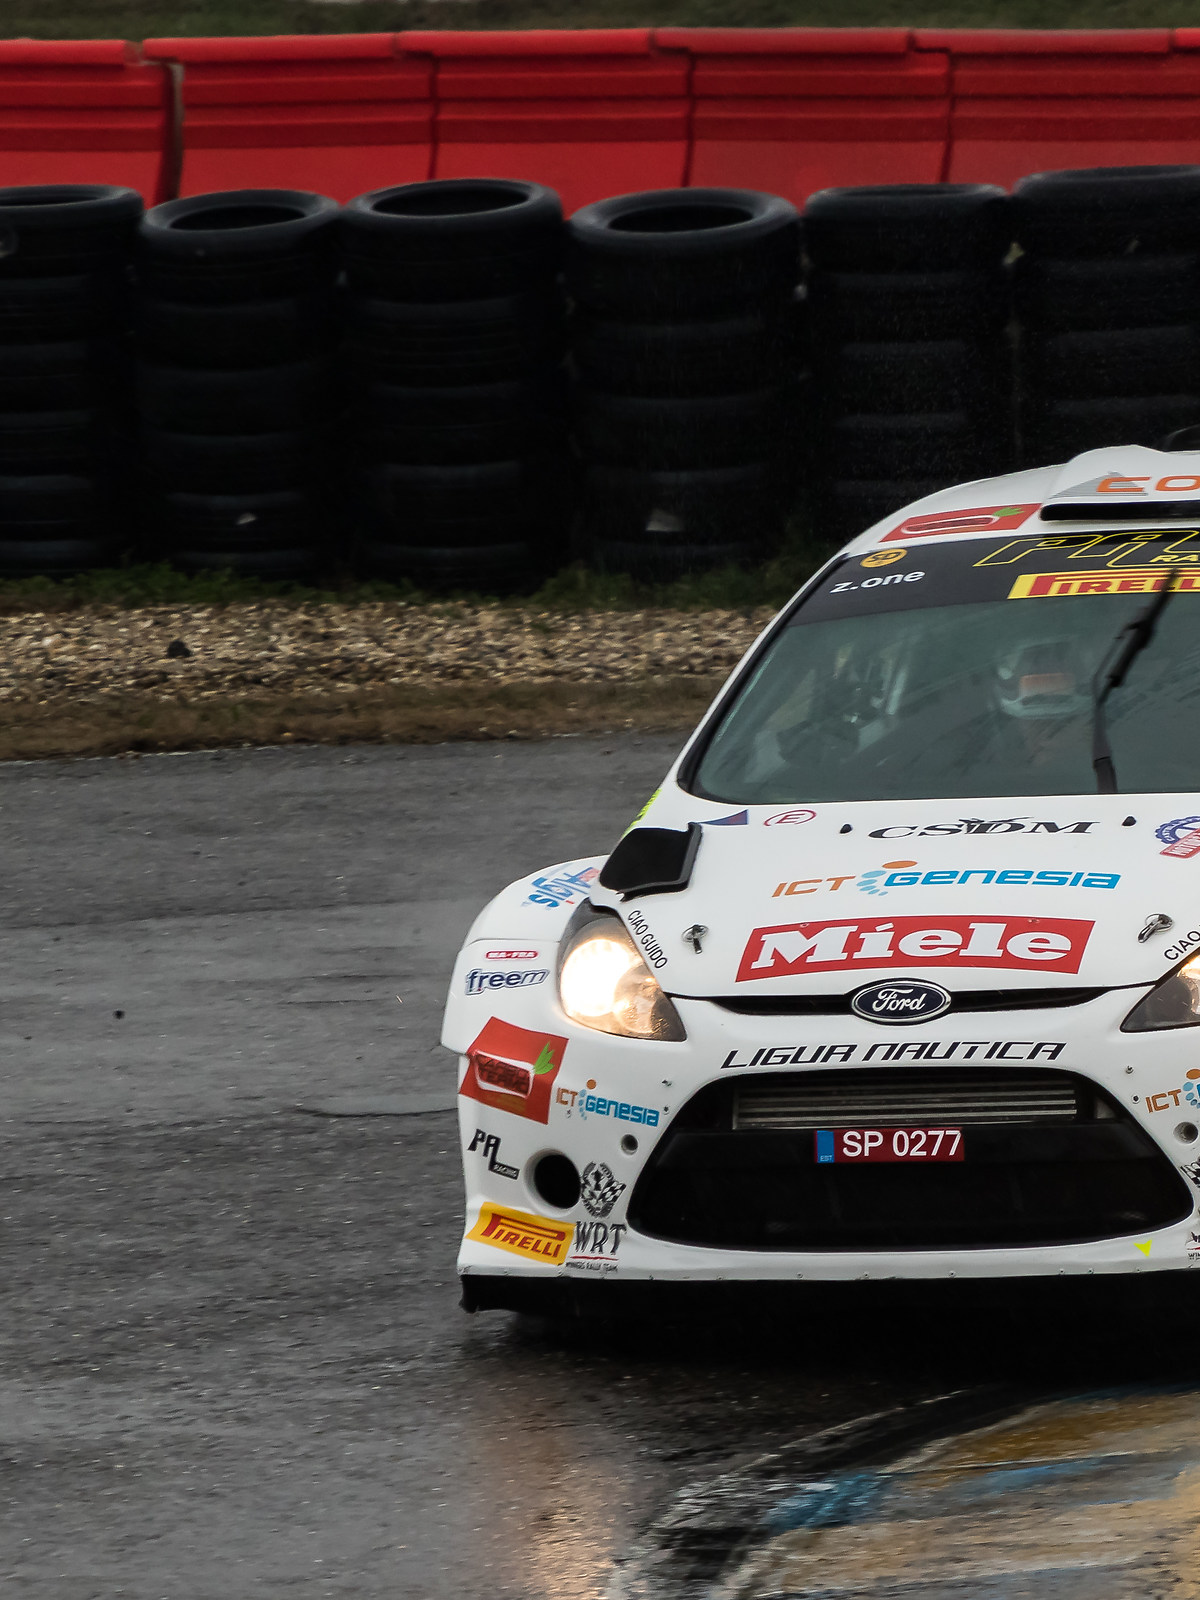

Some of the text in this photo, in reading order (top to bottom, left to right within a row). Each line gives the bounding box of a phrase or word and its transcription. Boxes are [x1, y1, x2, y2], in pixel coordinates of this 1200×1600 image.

[829, 571, 926, 594] z.one
[868, 819, 1101, 839] CSDM
[772, 875, 856, 898] ICT
[628, 910, 668, 969] CIAO GUIDO
[750, 922, 1072, 971] Miele
[468, 970, 547, 991] freem
[871, 987, 926, 1011] Ford
[721, 1041, 1067, 1069] LIGUR NAUTICA
[556, 1087, 578, 1107] ICT
[1145, 1088, 1181, 1113] ICT
[842, 1129, 963, 1158] SP 0277
[481, 1212, 566, 1258] PIRELLI
